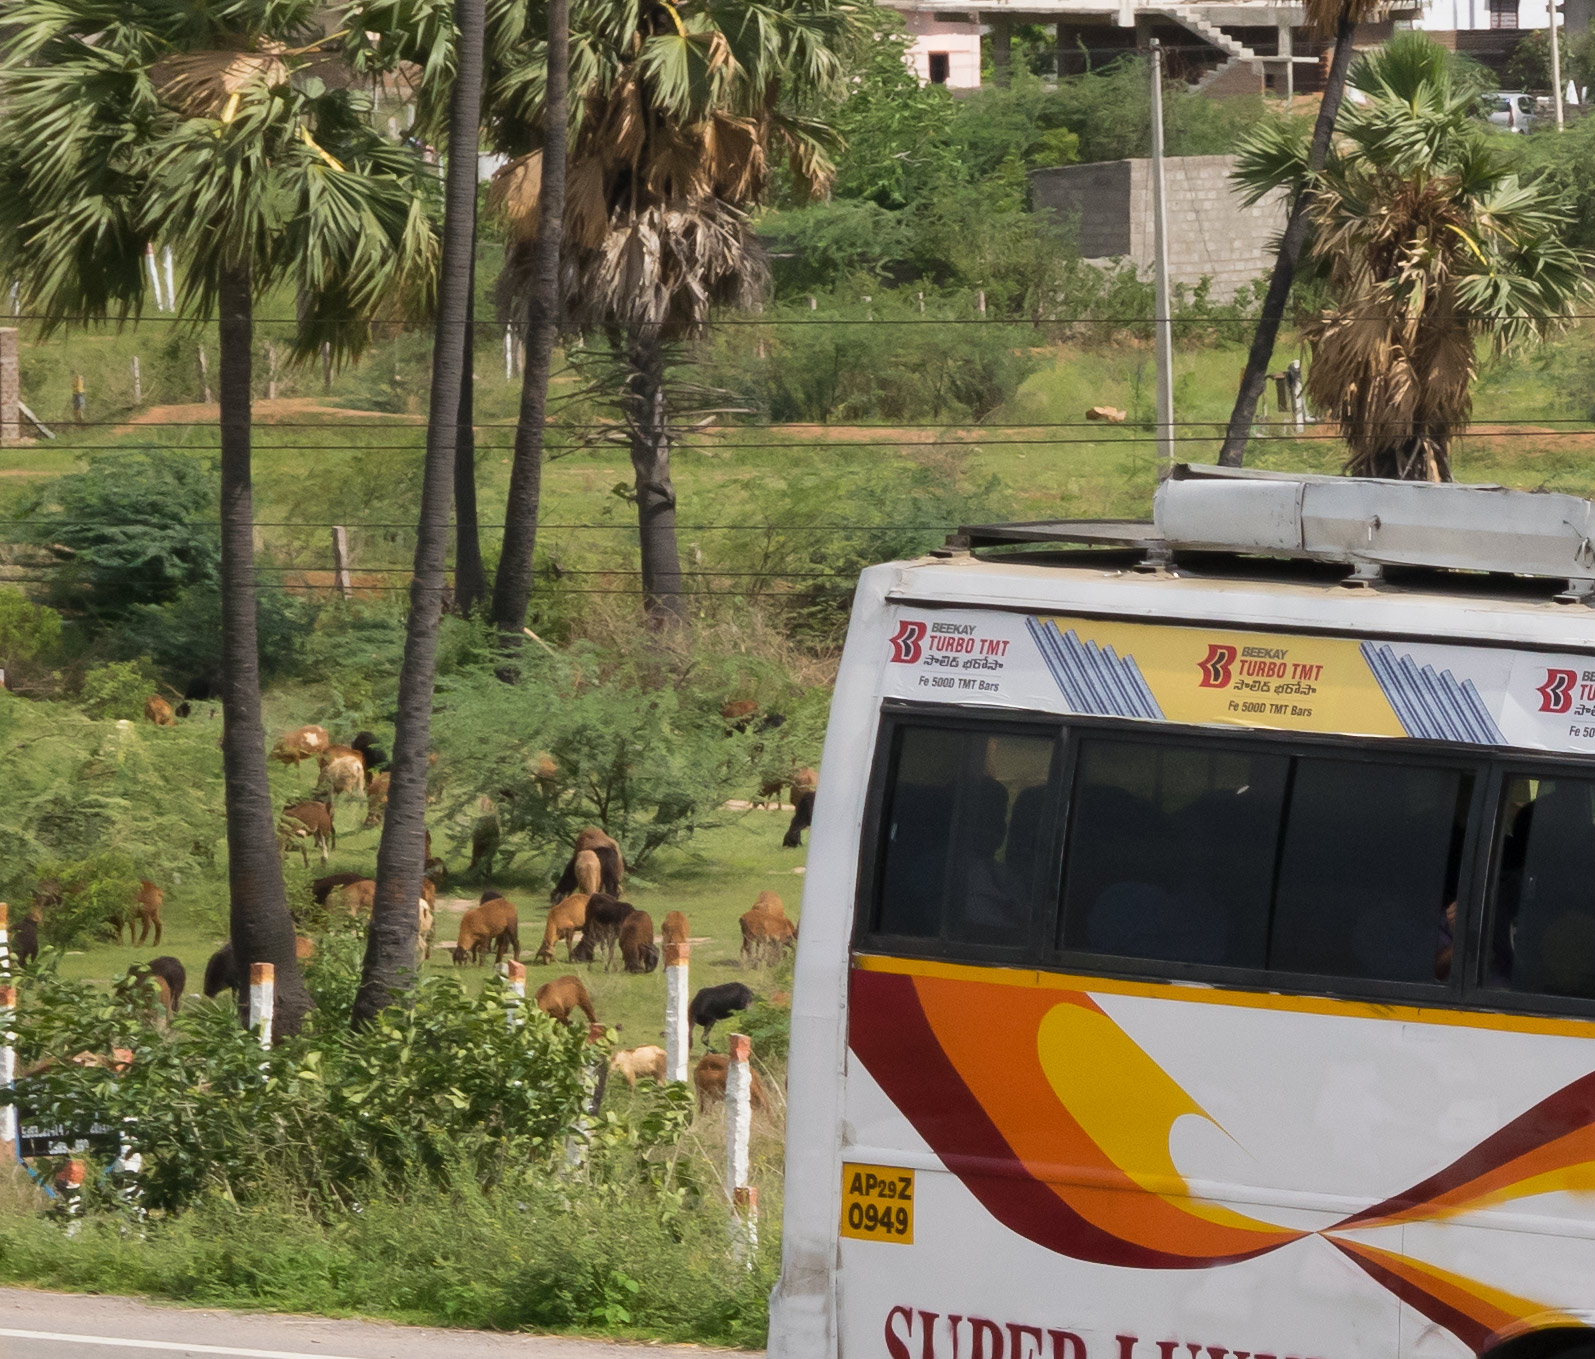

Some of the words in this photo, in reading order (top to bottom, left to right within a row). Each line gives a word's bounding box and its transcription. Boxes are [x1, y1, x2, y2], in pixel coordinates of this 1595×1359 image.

[932, 623, 976, 635] BEEKAY
[929, 635, 975, 653] TURBO
[980, 639, 1010, 656] TMT
[1242, 647, 1288, 659] BEEKAY
[1239, 660, 1287, 678] TURBO
[1292, 663, 1323, 681] TMT
[919, 676, 929, 686] Fe
[932, 677, 954, 688] 500D
[958, 679, 977, 689] TMT
[978, 680, 999, 691] Bars
[1228, 700, 1239, 711] Fe
[1242, 702, 1266, 712] 500D
[1269, 704, 1289, 714] TMT
[1291, 706, 1312, 716] Bars
[1569, 726, 1580, 736] Fe
[849, 1172, 911, 1200] AP29Z
[848, 1202, 908, 1235] 0949
